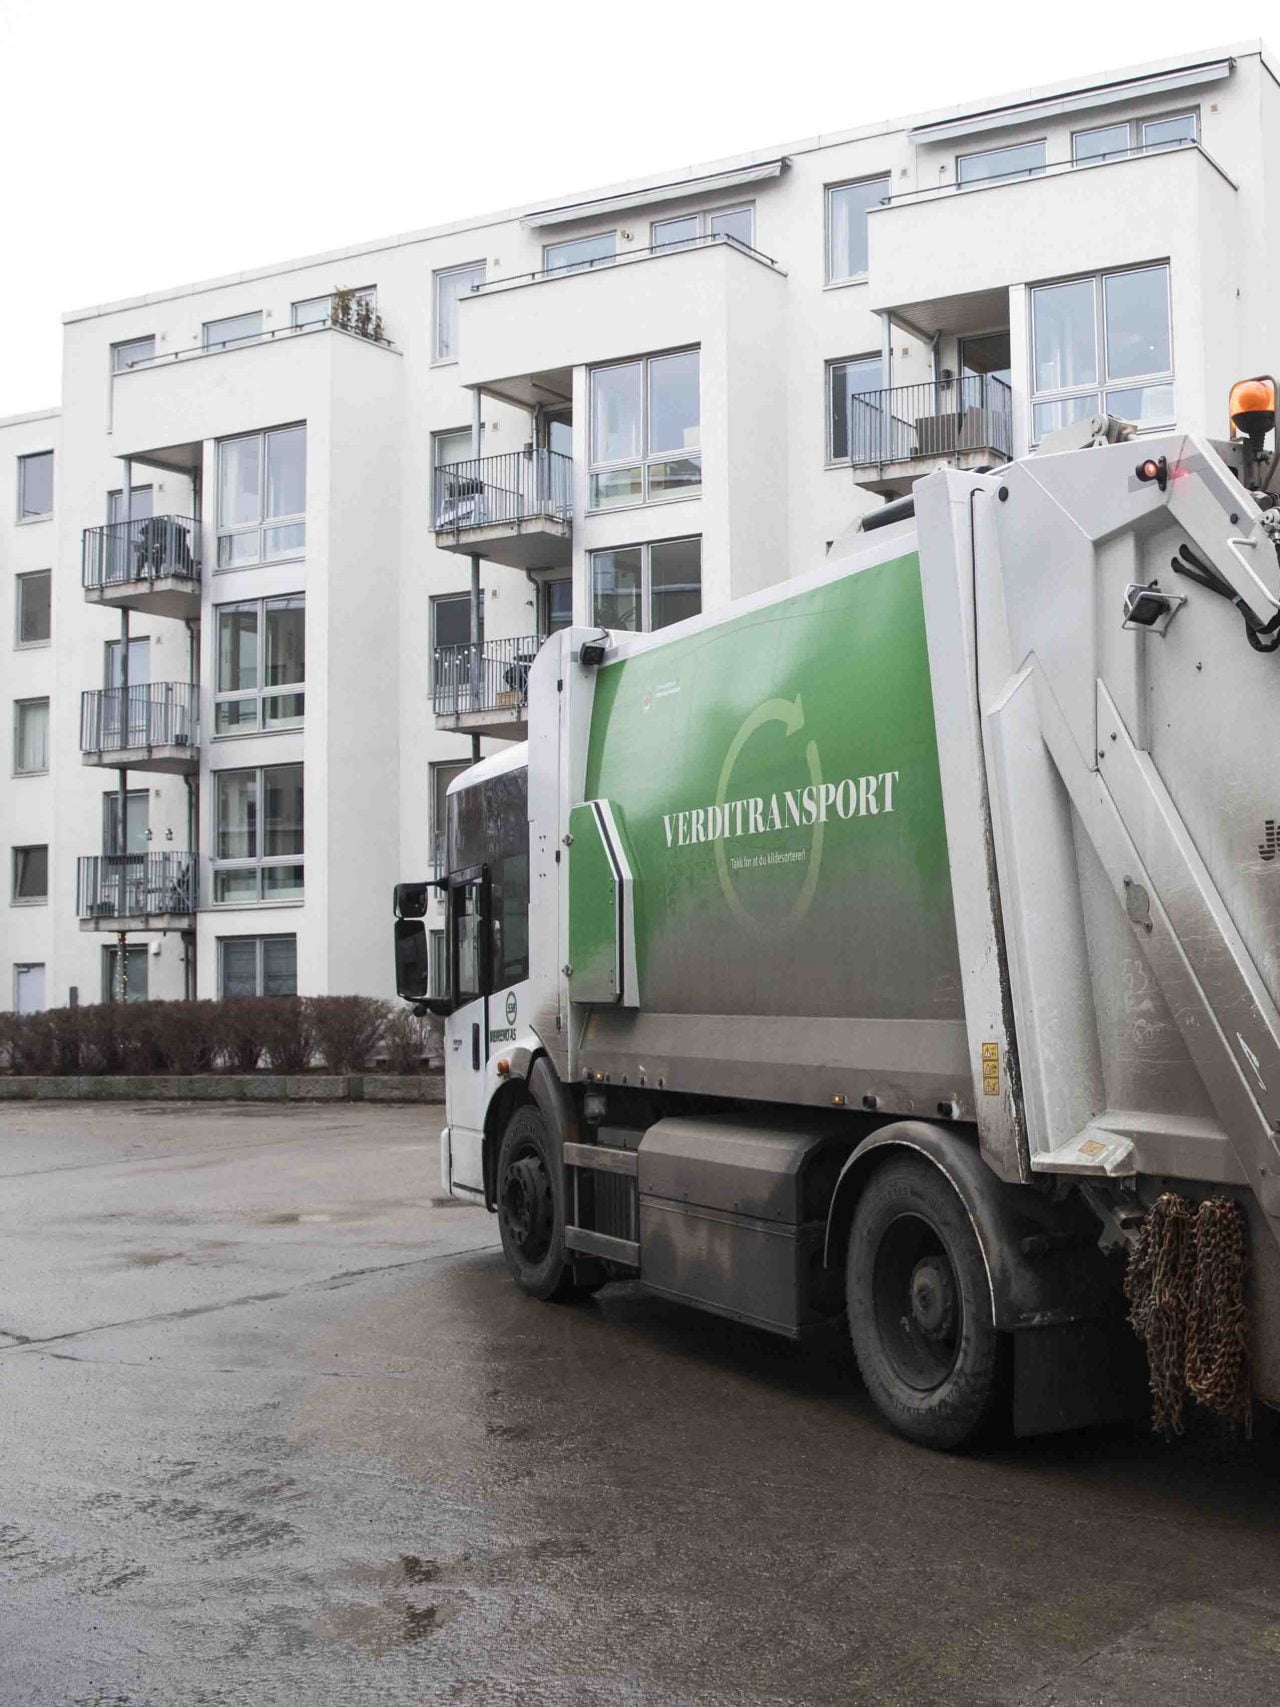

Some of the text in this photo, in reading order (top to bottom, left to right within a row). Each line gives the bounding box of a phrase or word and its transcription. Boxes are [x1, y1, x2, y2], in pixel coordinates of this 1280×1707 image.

[662, 771, 899, 848] VERDITRANSPORT
[730, 857, 744, 869] Takk
[744, 856, 752, 868] for
[759, 854, 767, 866] du
